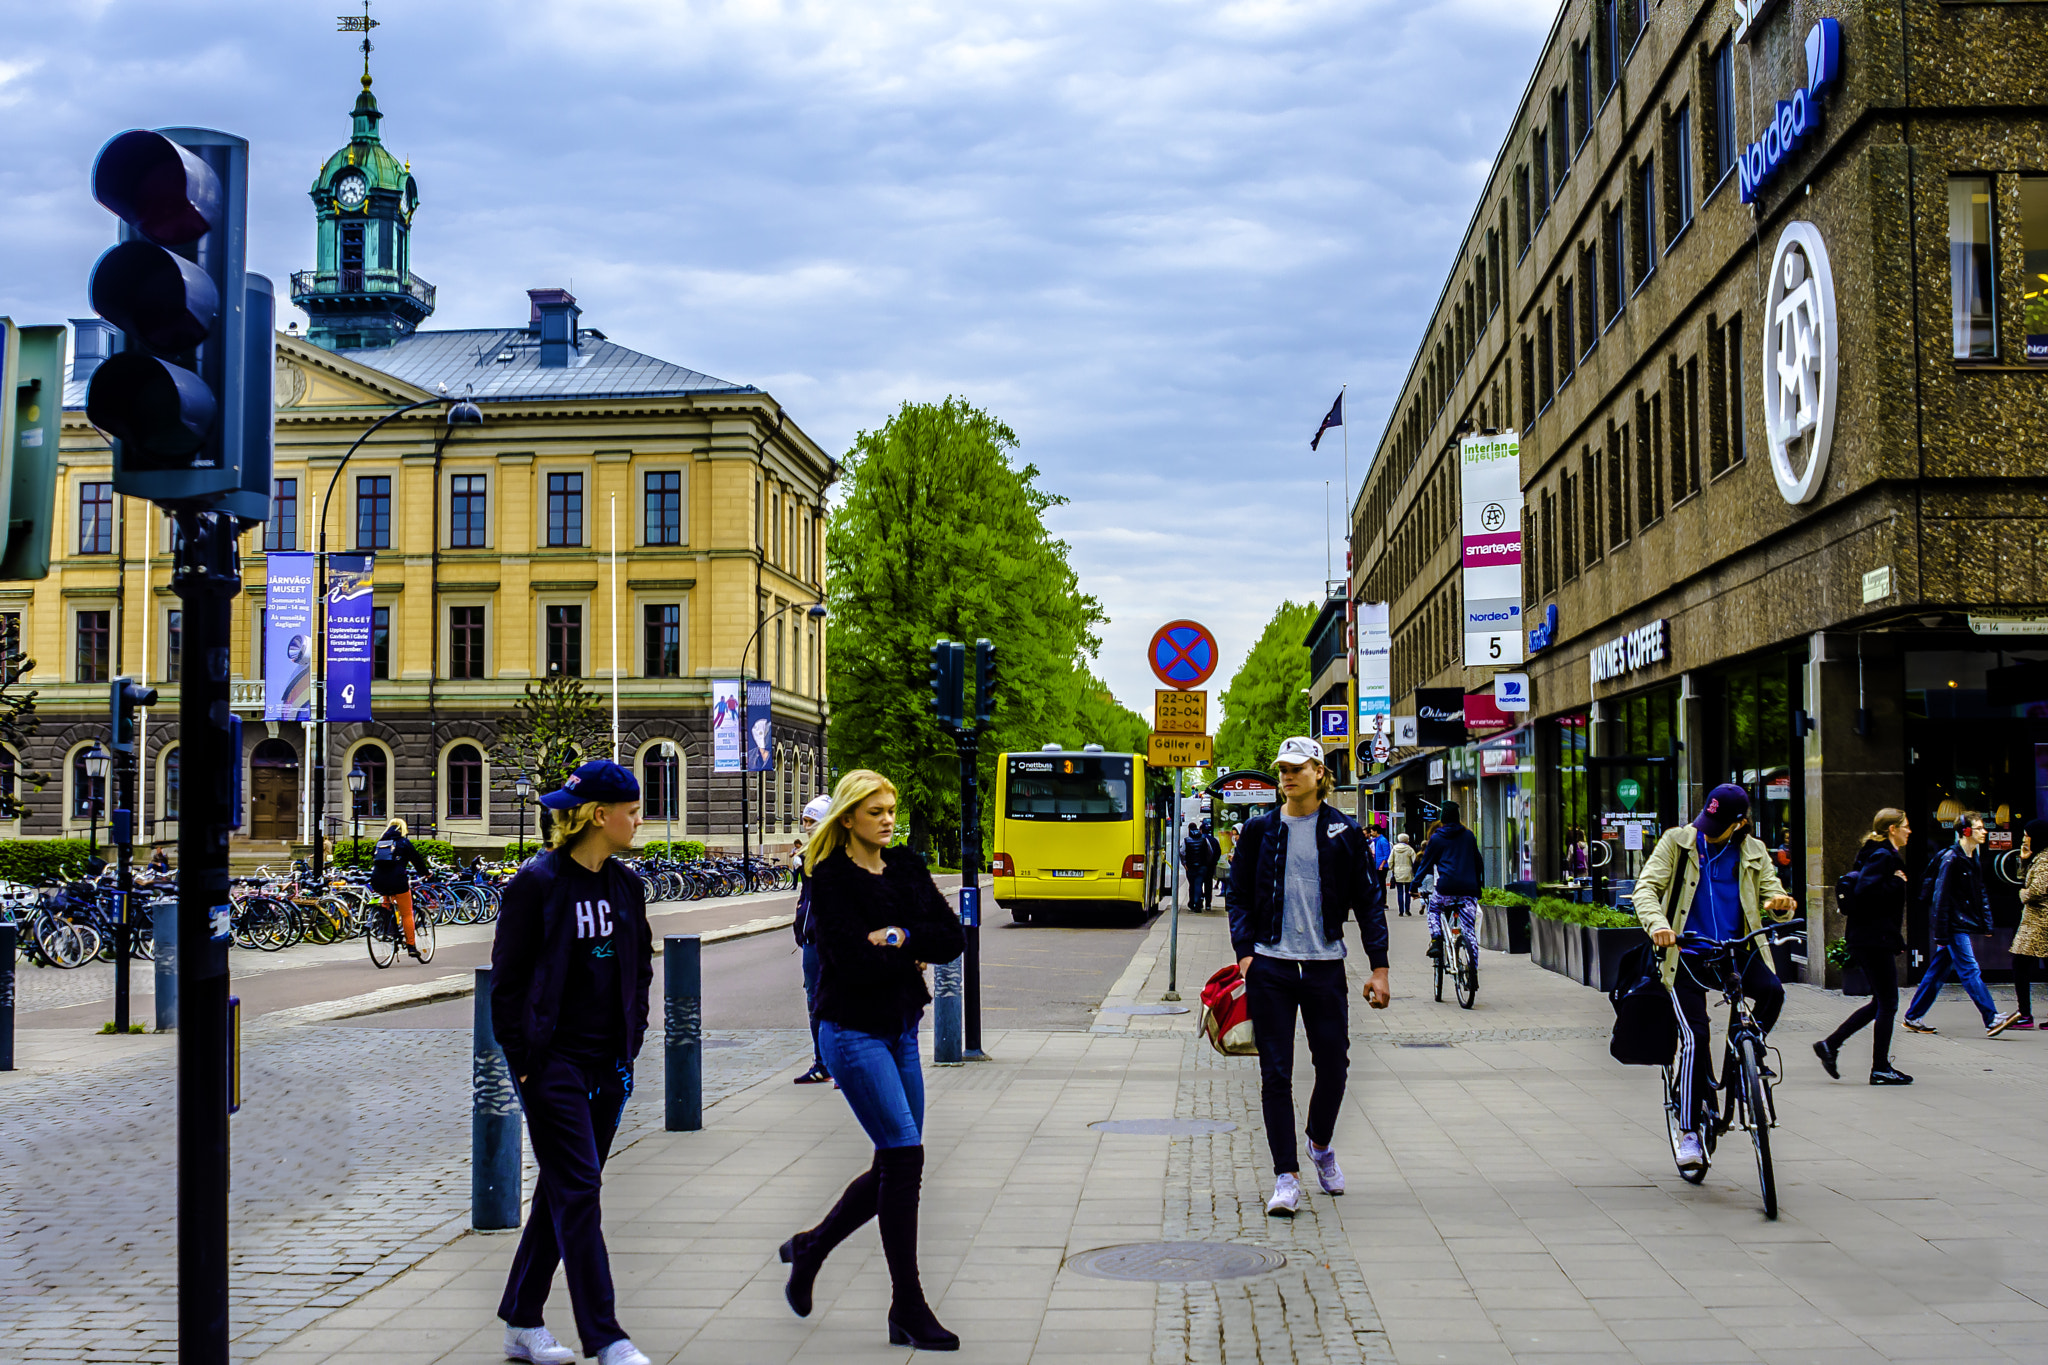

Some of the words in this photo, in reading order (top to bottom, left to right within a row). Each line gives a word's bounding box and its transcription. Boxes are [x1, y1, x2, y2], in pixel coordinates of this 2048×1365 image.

[1738, 88, 1806, 204] Nordea
[1464, 441, 1508, 455] interlan
[1466, 542, 1522, 556] smarteyes
[268, 575, 311, 585] JÄRNVÄGS
[272, 585, 307, 593] MUSEET
[328, 615, 371, 624] Å-DRAGET
[1469, 612, 1509, 622] Nordea
[1360, 647, 1388, 656] frösunda
[1489, 636, 1502, 659] 5
[1589, 635, 1626, 685] WAYNES
[1626, 618, 1665, 672] COFFEE
[1162, 692, 1200, 704] 22-04
[1158, 706, 1203, 718] (22-04)
[1161, 719, 1200, 730] 22-04
[1328, 713, 1343, 732] P
[1154, 737, 1190, 749] Gäller
[1194, 738, 1206, 753] ej
[1168, 752, 1191, 763] taxi
[1235, 780, 1243, 790] C
[575, 899, 614, 939] HC
